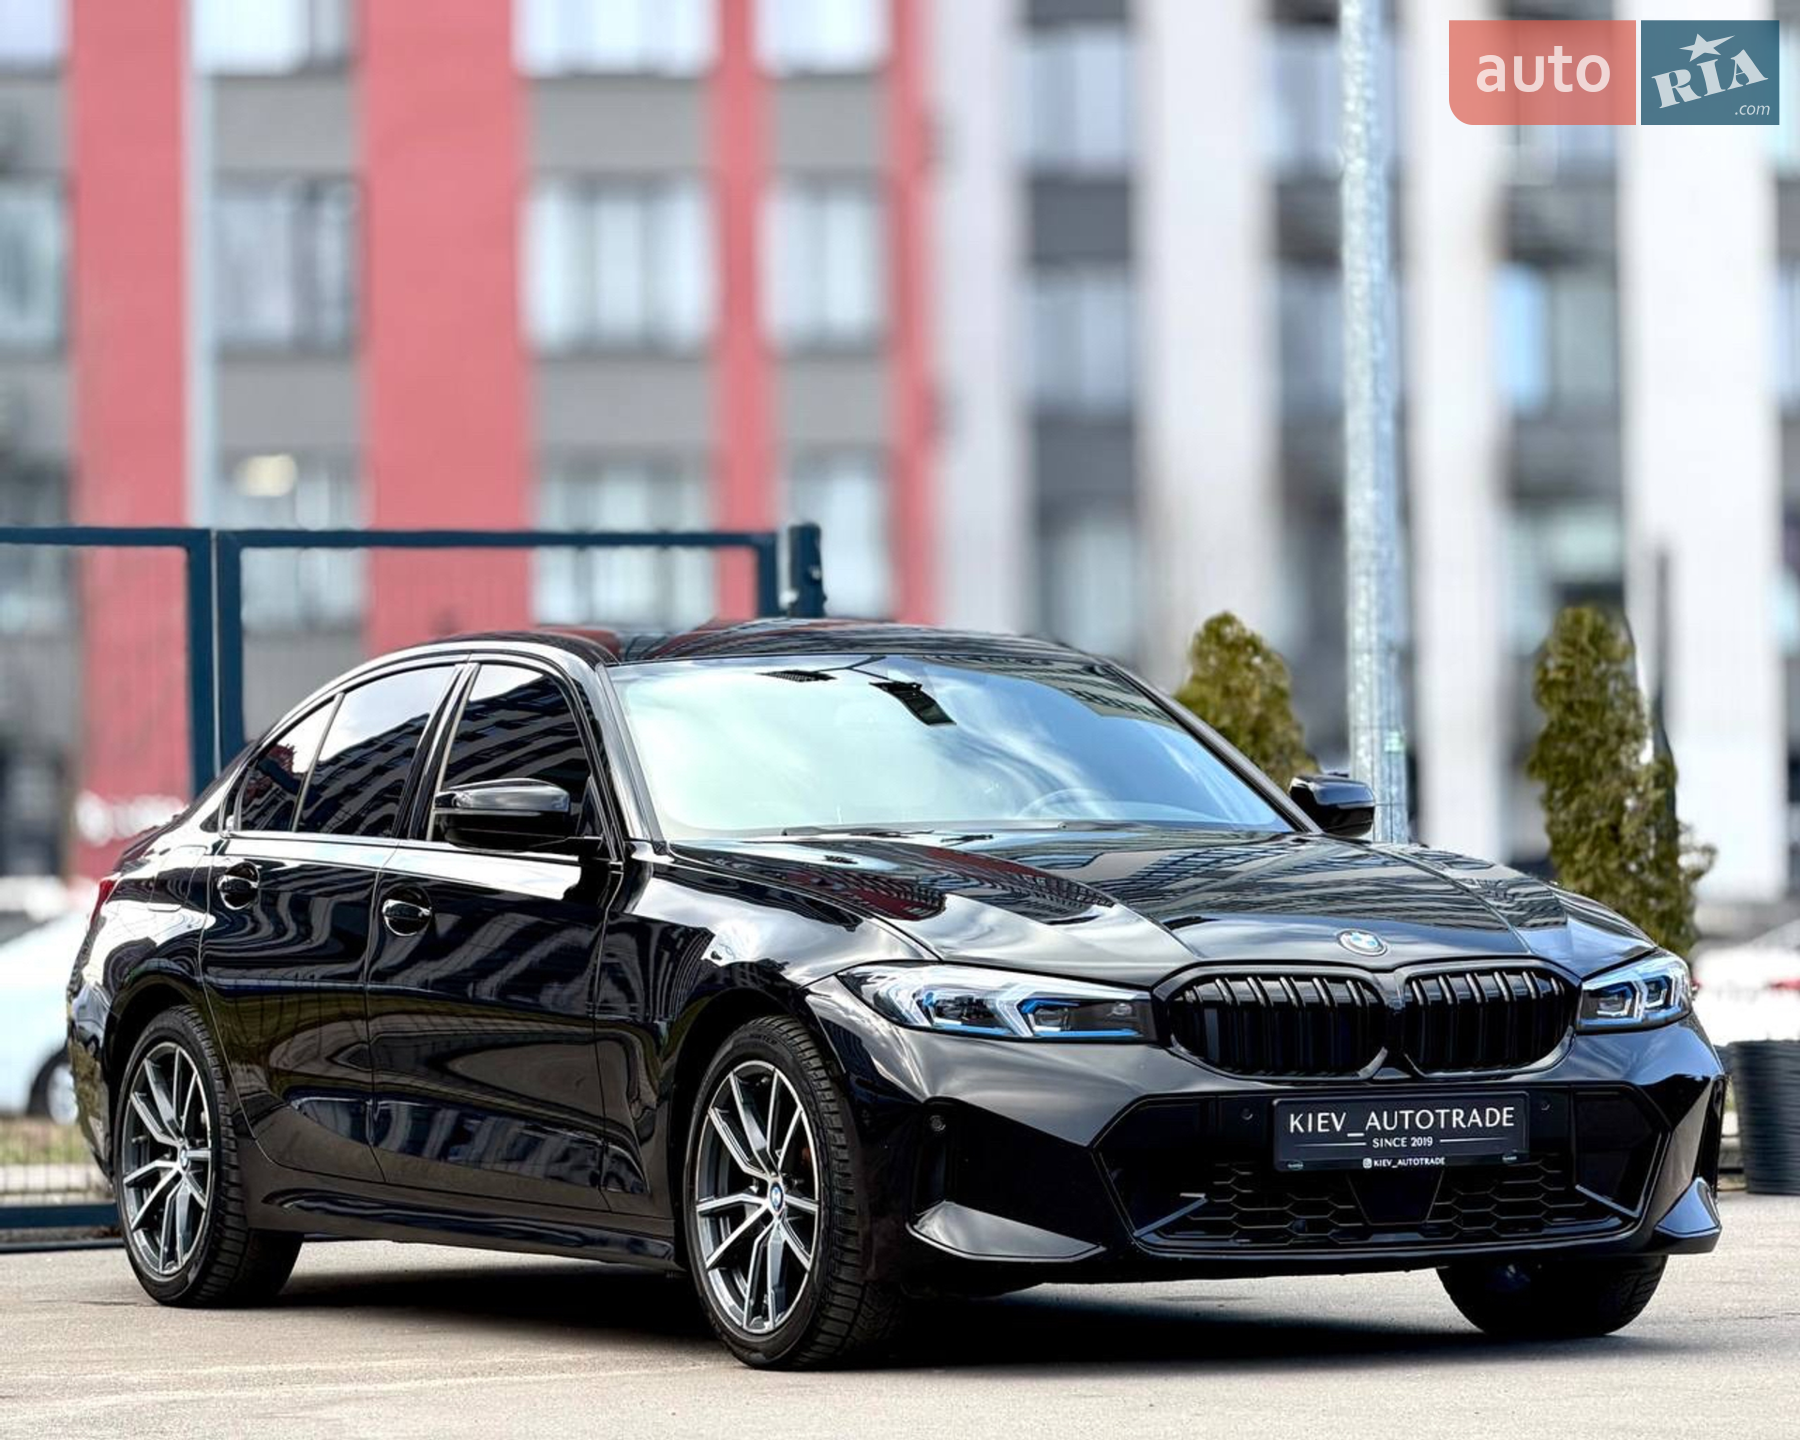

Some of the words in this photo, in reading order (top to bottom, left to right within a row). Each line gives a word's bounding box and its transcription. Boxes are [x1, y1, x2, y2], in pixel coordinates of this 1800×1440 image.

[1289, 1107, 1515, 1137] KIEV_AUTOTRADE
[1372, 1138, 1408, 1148] SINCE
[1411, 1137, 1433, 1147] 2019
[1373, 1157, 1446, 1169] KIEV_AUTOTRADE
